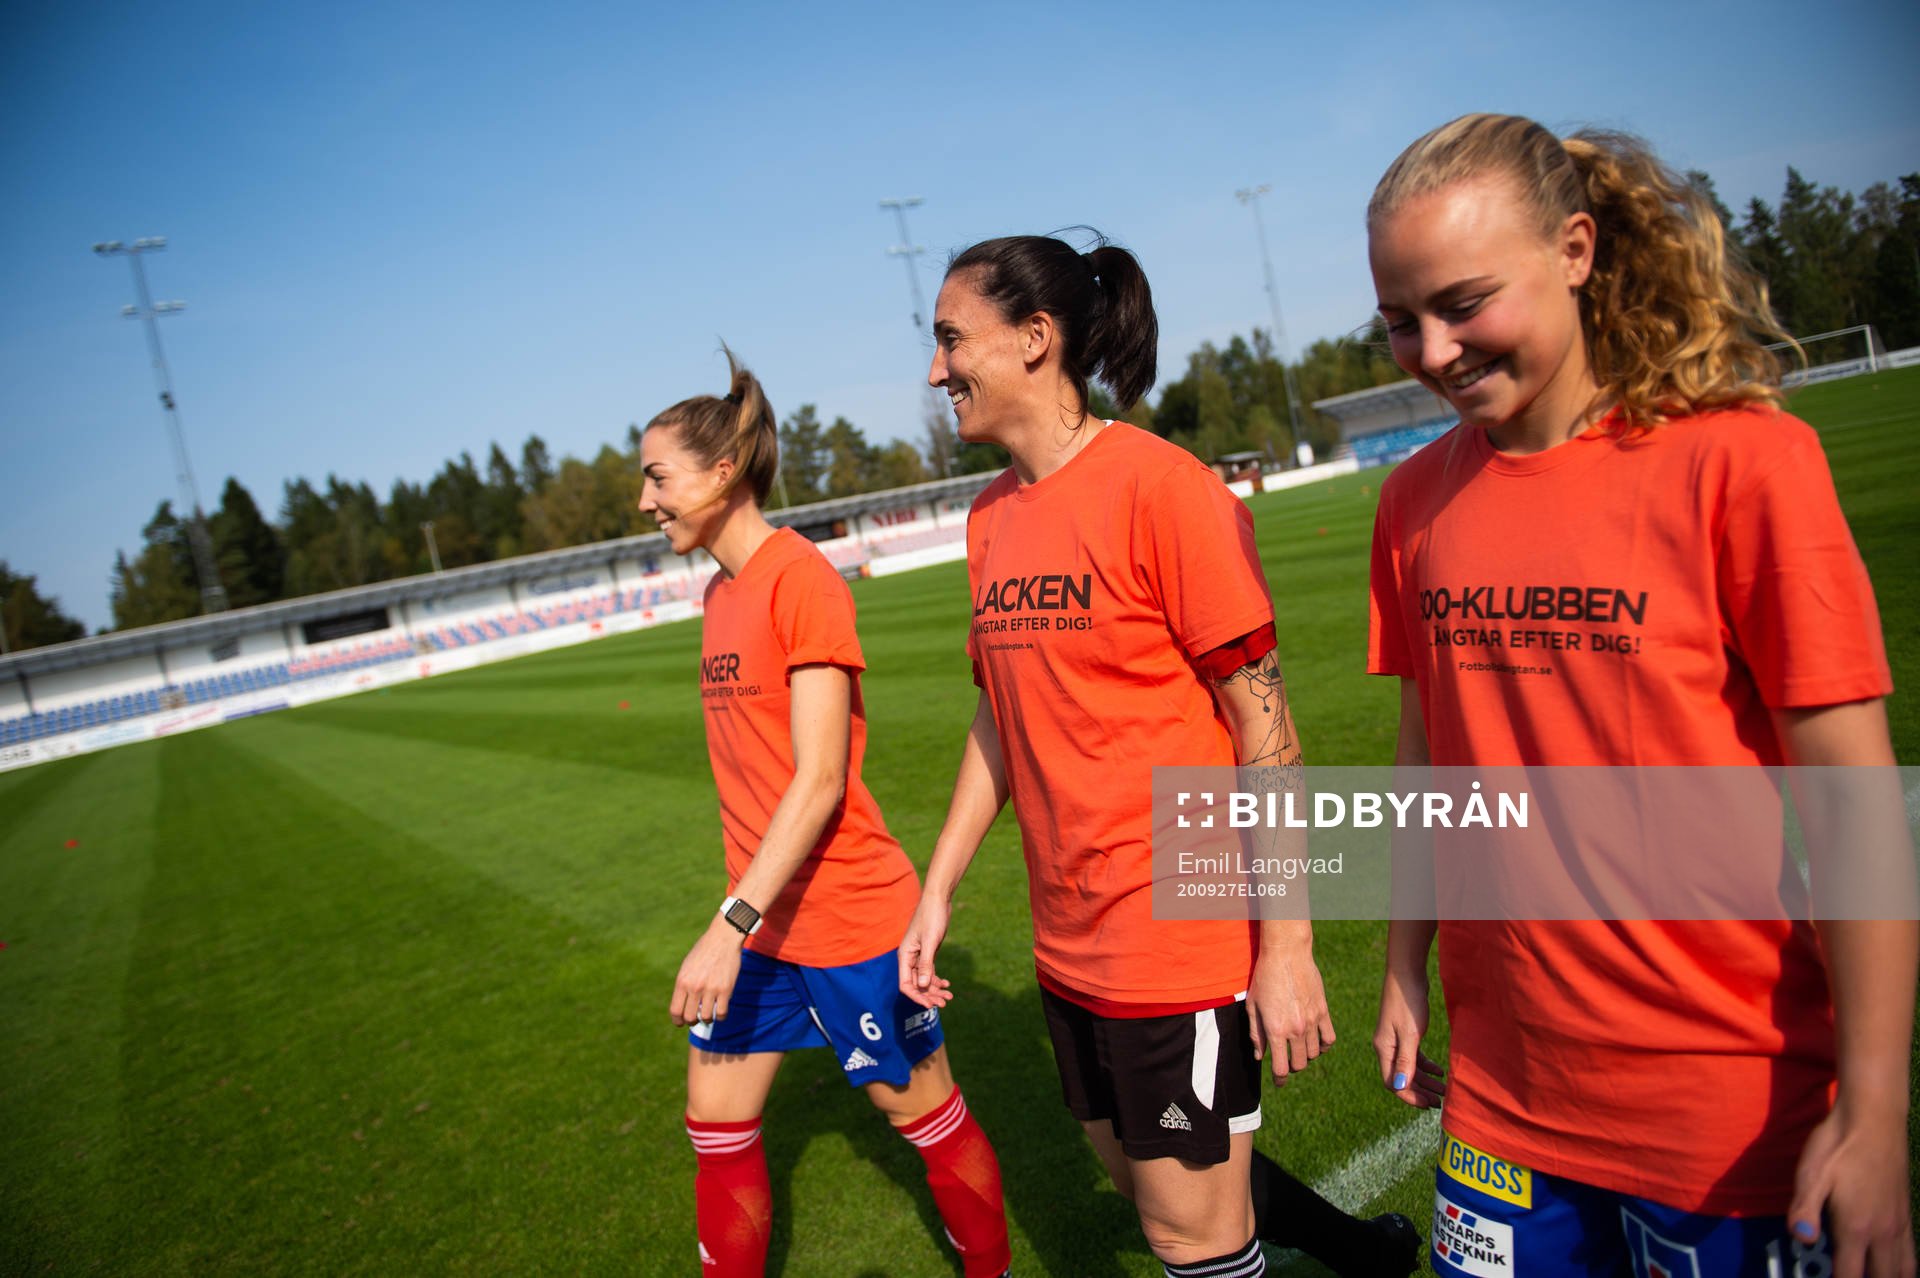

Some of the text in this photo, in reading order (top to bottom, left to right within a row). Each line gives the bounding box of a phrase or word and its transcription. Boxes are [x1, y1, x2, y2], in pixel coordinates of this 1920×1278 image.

[975, 574, 1091, 617] LACKEN
[1010, 616, 1049, 631] EFTER
[1056, 617, 1093, 631] DIG!
[1429, 624, 1641, 655] ÅNGTAR EFTER DIG!
[737, 685, 762, 697] DIG!
[859, 1012, 882, 1041] 6
[1160, 1116, 1192, 1131] adidas
[1450, 1141, 1523, 1196] GROSS
